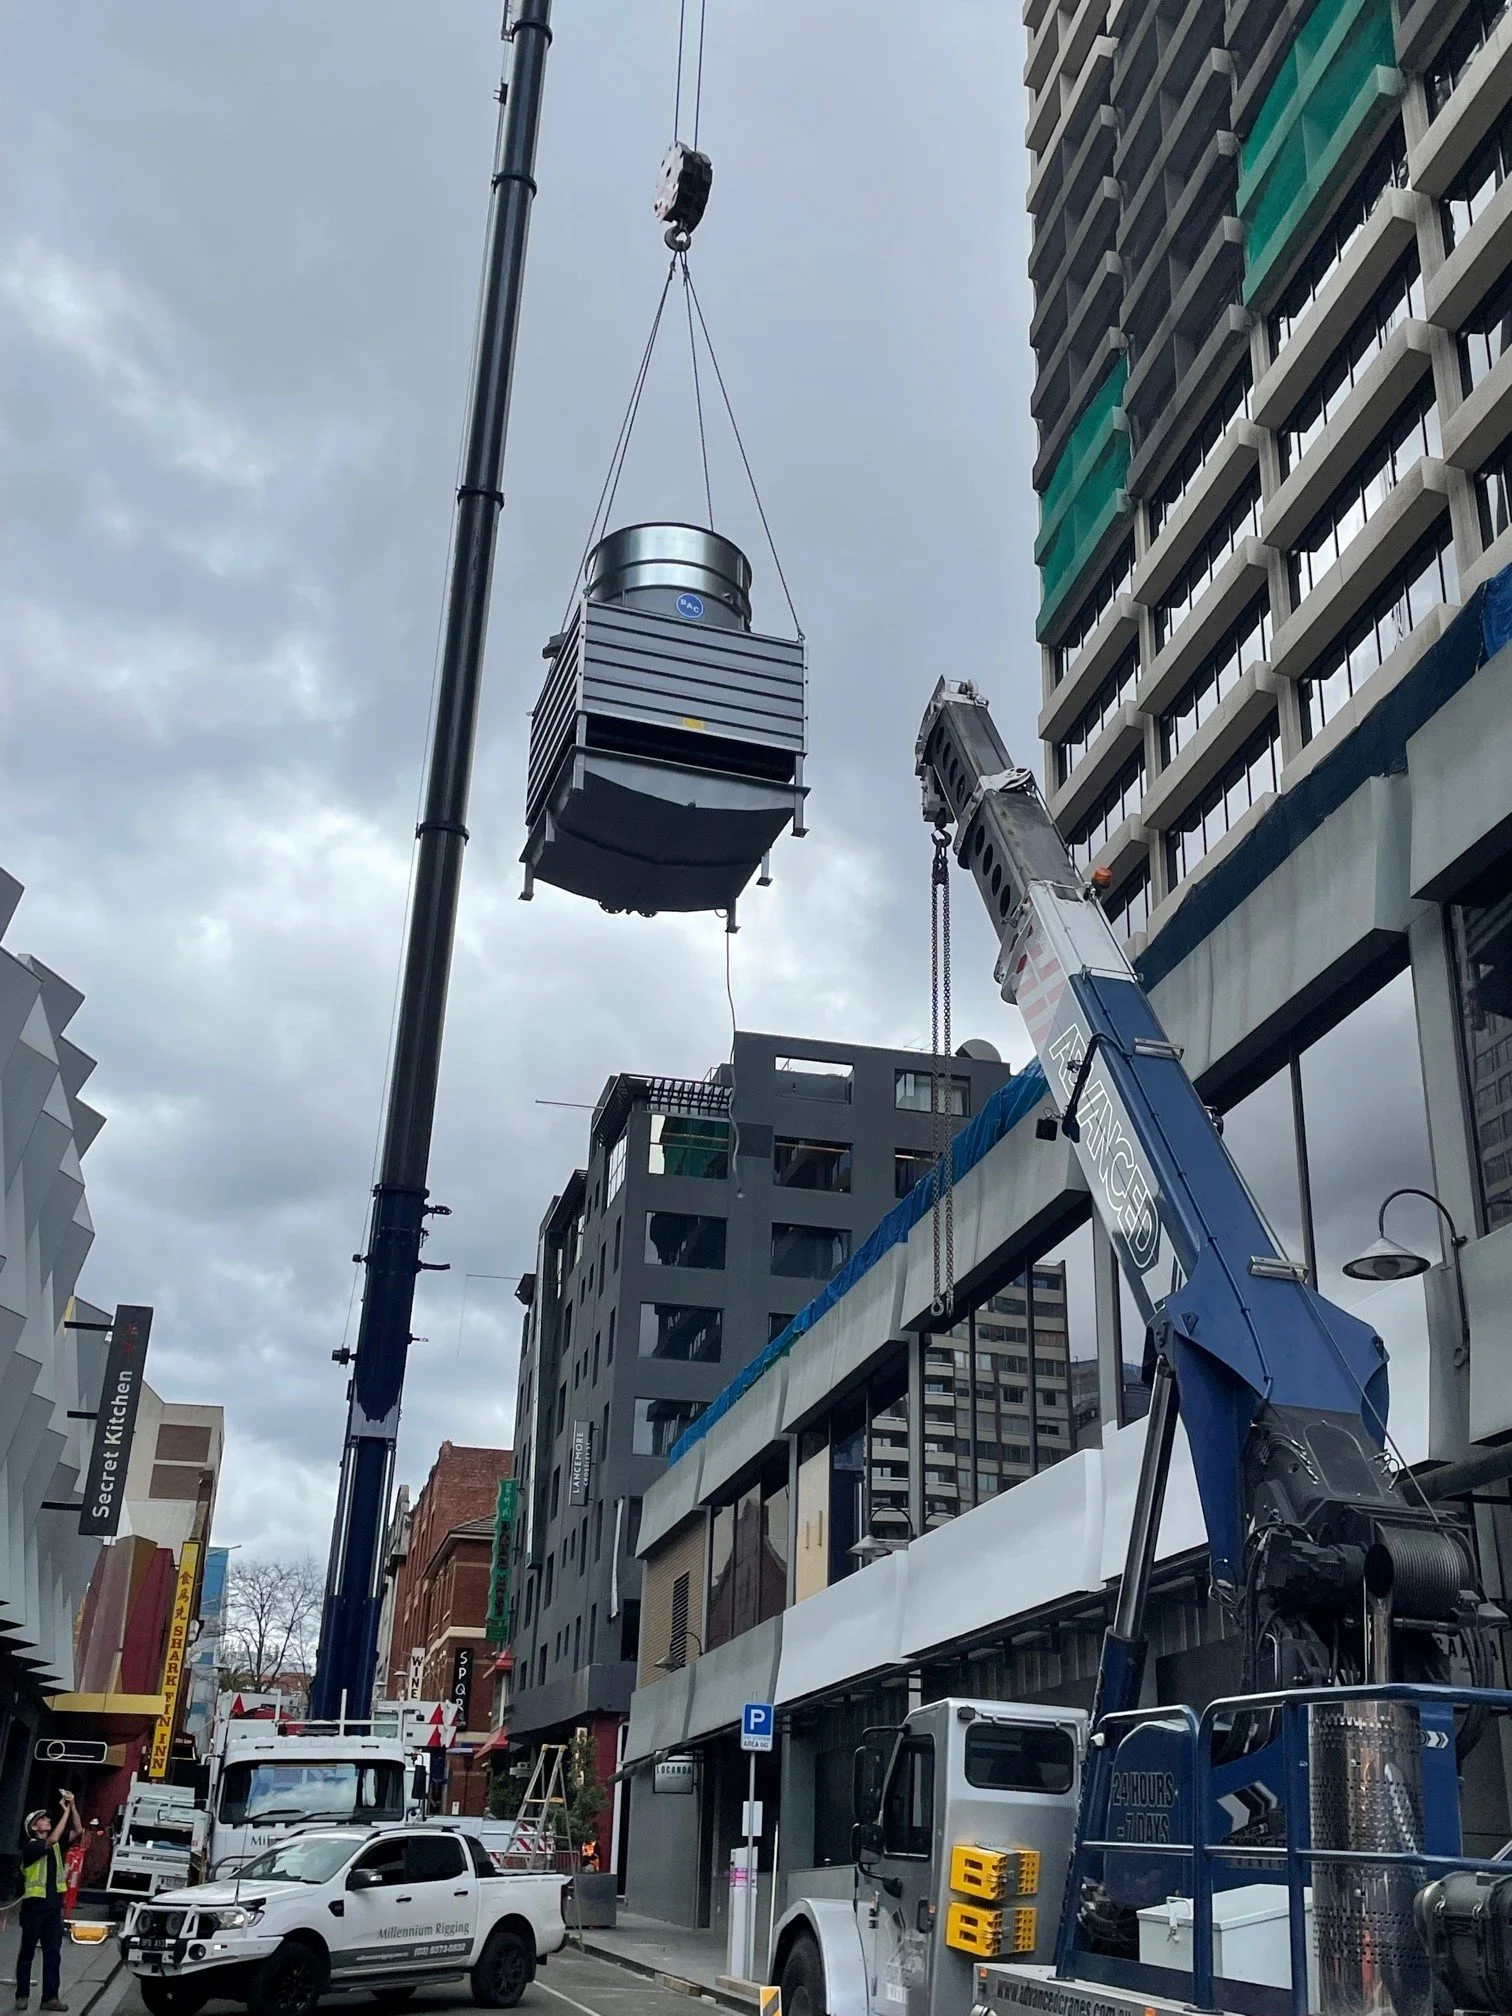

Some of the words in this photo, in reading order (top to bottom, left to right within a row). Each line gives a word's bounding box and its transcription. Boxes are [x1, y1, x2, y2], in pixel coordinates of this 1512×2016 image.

[680, 598, 700, 613] BAC
[104, 1370, 132, 1445] Kitchen
[572, 1432, 584, 1494] LANCEMORE
[92, 1451, 119, 1519] Secret
[166, 1625, 183, 1686] SHARK
[411, 1656, 424, 1699] WINE
[455, 1651, 468, 1711] SPQR
[157, 1691, 174, 1727] FIN
[750, 1709, 766, 1730] P
[151, 1733, 167, 1769] INN
[656, 1765, 692, 1775] LOCANDA
[1111, 1772, 1129, 1806] 24
[1130, 1771, 1174, 1807] HOURS
[1136, 1812, 1170, 1844] DAYS
[377, 1924, 433, 1940] Millennium
[435, 1921, 470, 1936] Rigging
